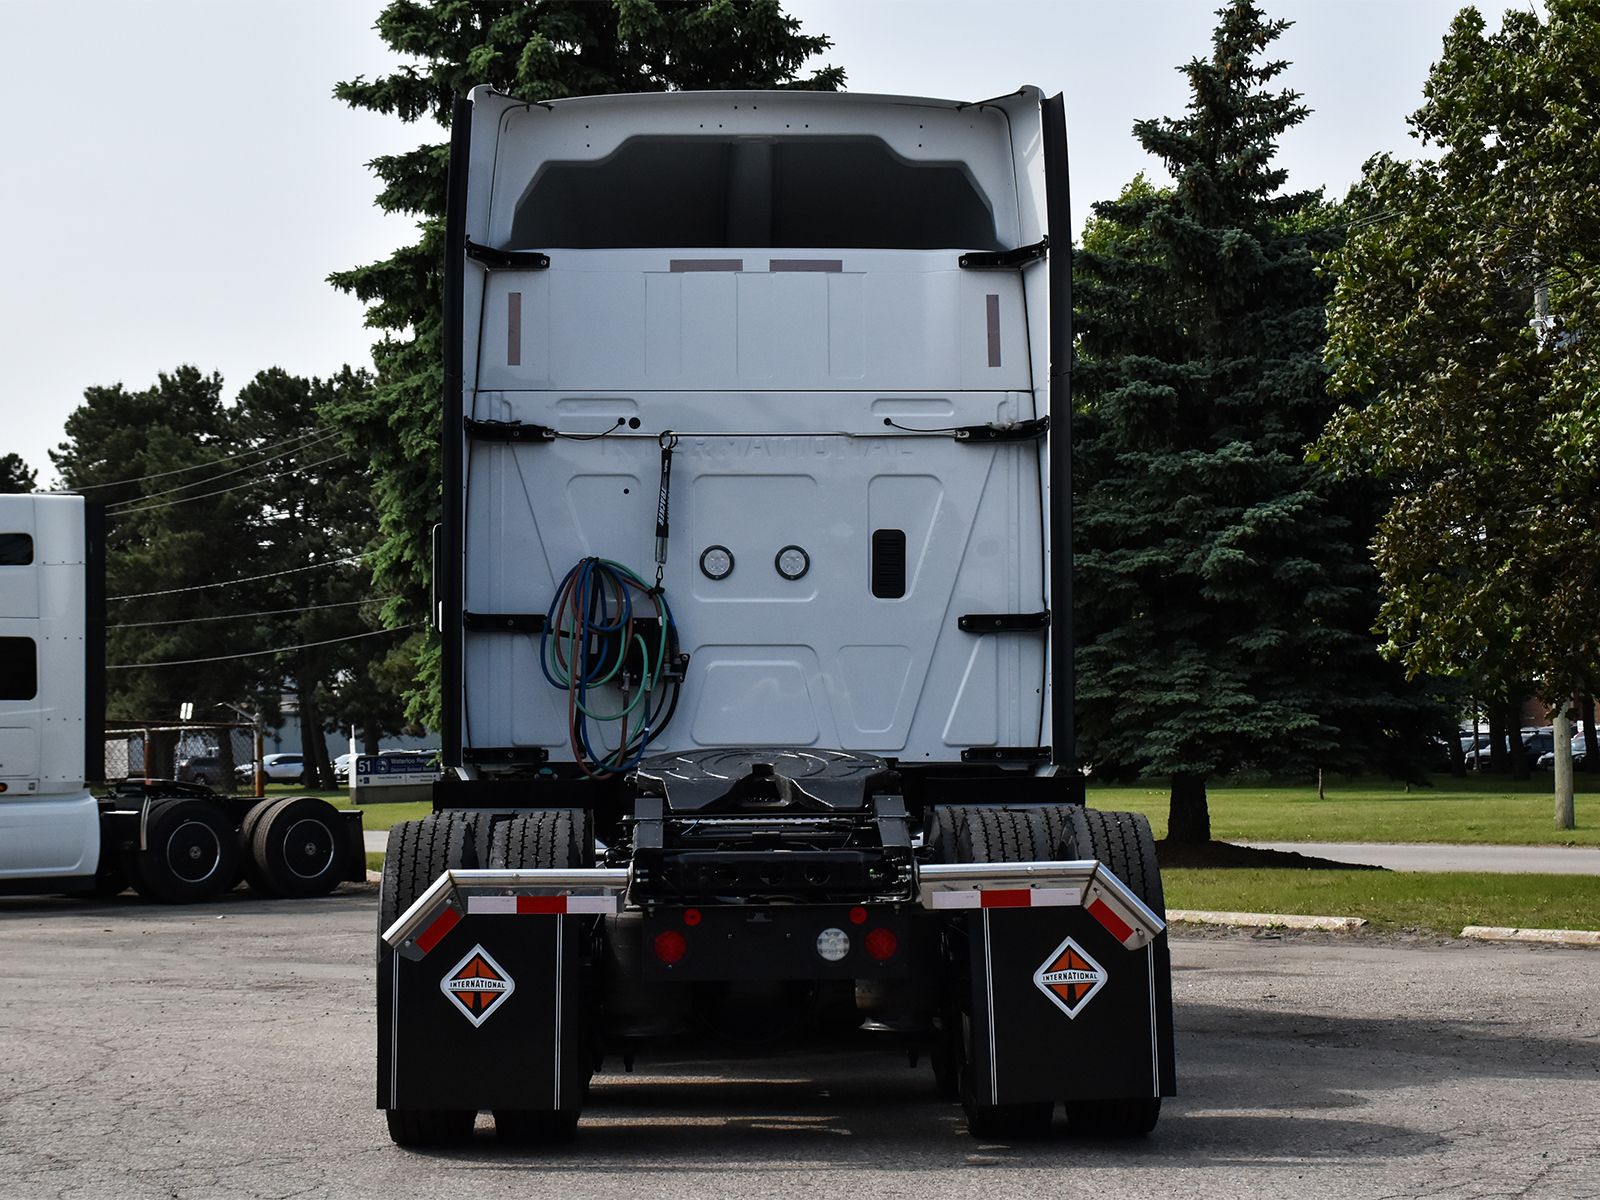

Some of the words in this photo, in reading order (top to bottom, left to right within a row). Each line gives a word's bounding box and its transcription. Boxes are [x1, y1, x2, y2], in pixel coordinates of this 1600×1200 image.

[358, 760, 371, 772] 51
[1043, 972, 1097, 981] INTERNATIONAL
[450, 979, 505, 988] INTERNATIONAL
